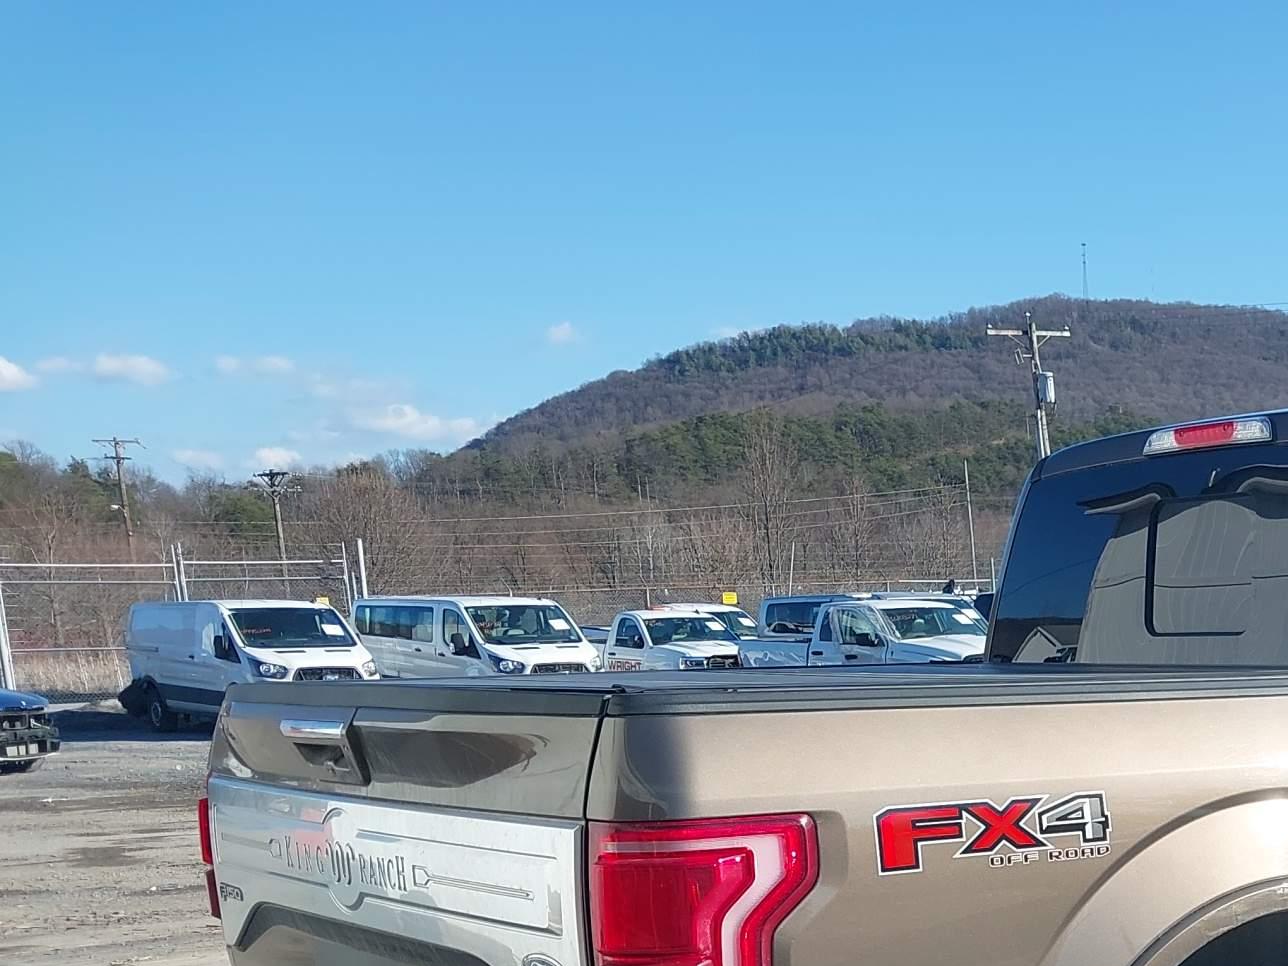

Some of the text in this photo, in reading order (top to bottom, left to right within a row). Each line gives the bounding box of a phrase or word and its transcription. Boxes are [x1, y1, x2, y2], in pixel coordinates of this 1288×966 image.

[607, 659, 642, 672] WRIGHT
[873, 790, 1112, 876] FX4
[284, 834, 409, 893] KING RANCH
[989, 845, 1111, 867] OFF ROAD
